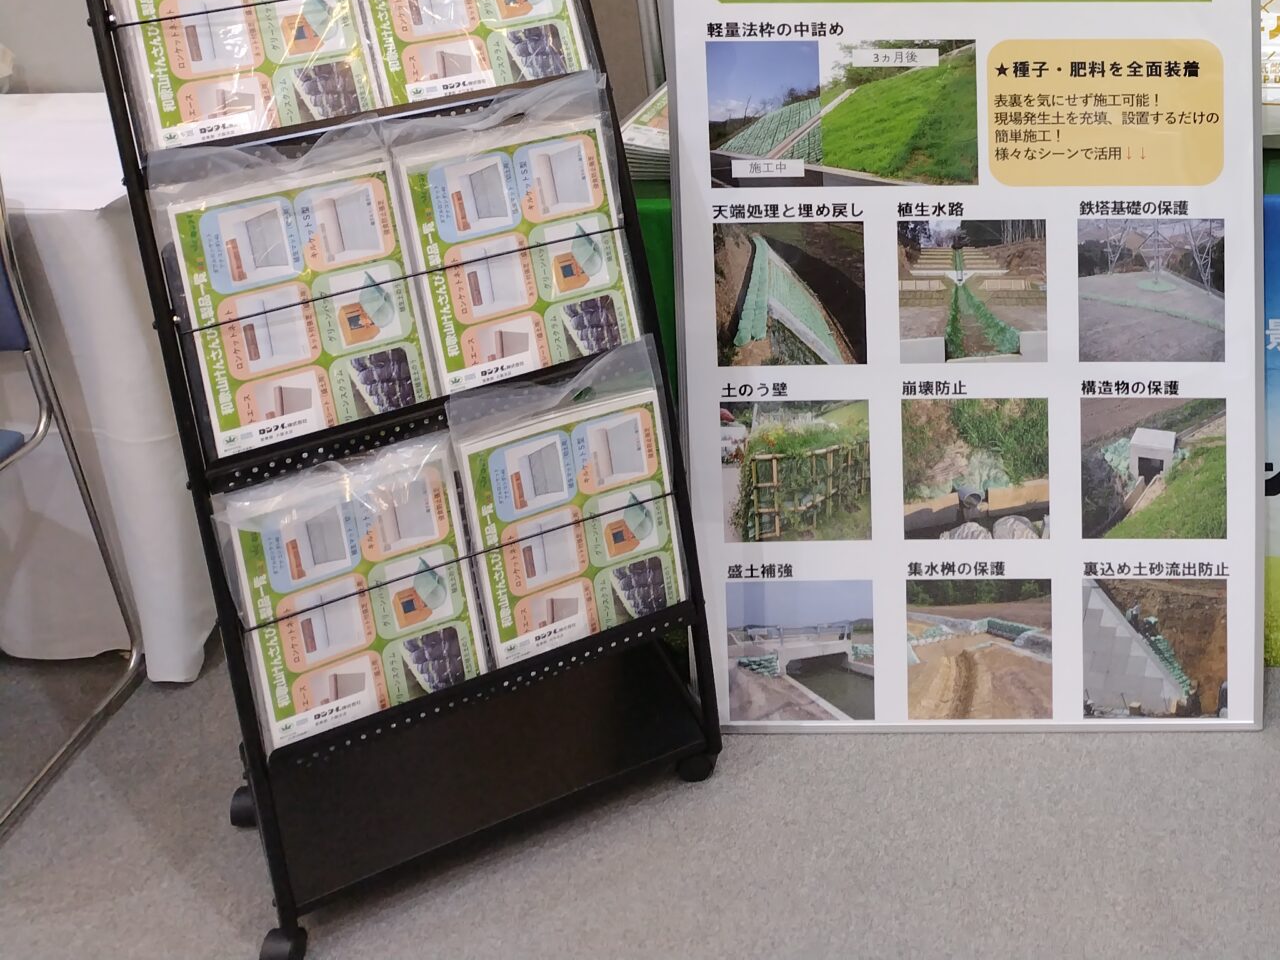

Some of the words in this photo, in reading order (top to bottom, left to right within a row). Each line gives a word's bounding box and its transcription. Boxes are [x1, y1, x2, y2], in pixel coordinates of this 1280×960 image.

[166, 8, 186, 69] ロンケットネト
[706, 21, 845, 39] 軽量法枠の中詰め
[994, 93, 1159, 108] 表裏を気にせず施工可能！
[995, 129, 1061, 143] 簡単施工！
[749, 161, 787, 175] 施工中
[712, 202, 864, 220] 天端処理と埋め戻し
[897, 202, 965, 218] 植生水路
[1079, 200, 1190, 217] 鉄塔基礎の保護
[451, 256, 468, 314] ロンケットネト
[224, 308, 244, 369] ロンケットネト
[722, 382, 788, 399] 土のう壁
[902, 381, 968, 397] 崩壊防止
[1081, 381, 1180, 396] 構造物の保護
[506, 535, 522, 587] ロンケットネト
[1083, 560, 1231, 578] 裏込め土砂流出防止
[727, 562, 794, 579] 盛土補強
[282, 607, 300, 663] ロンケットネト
